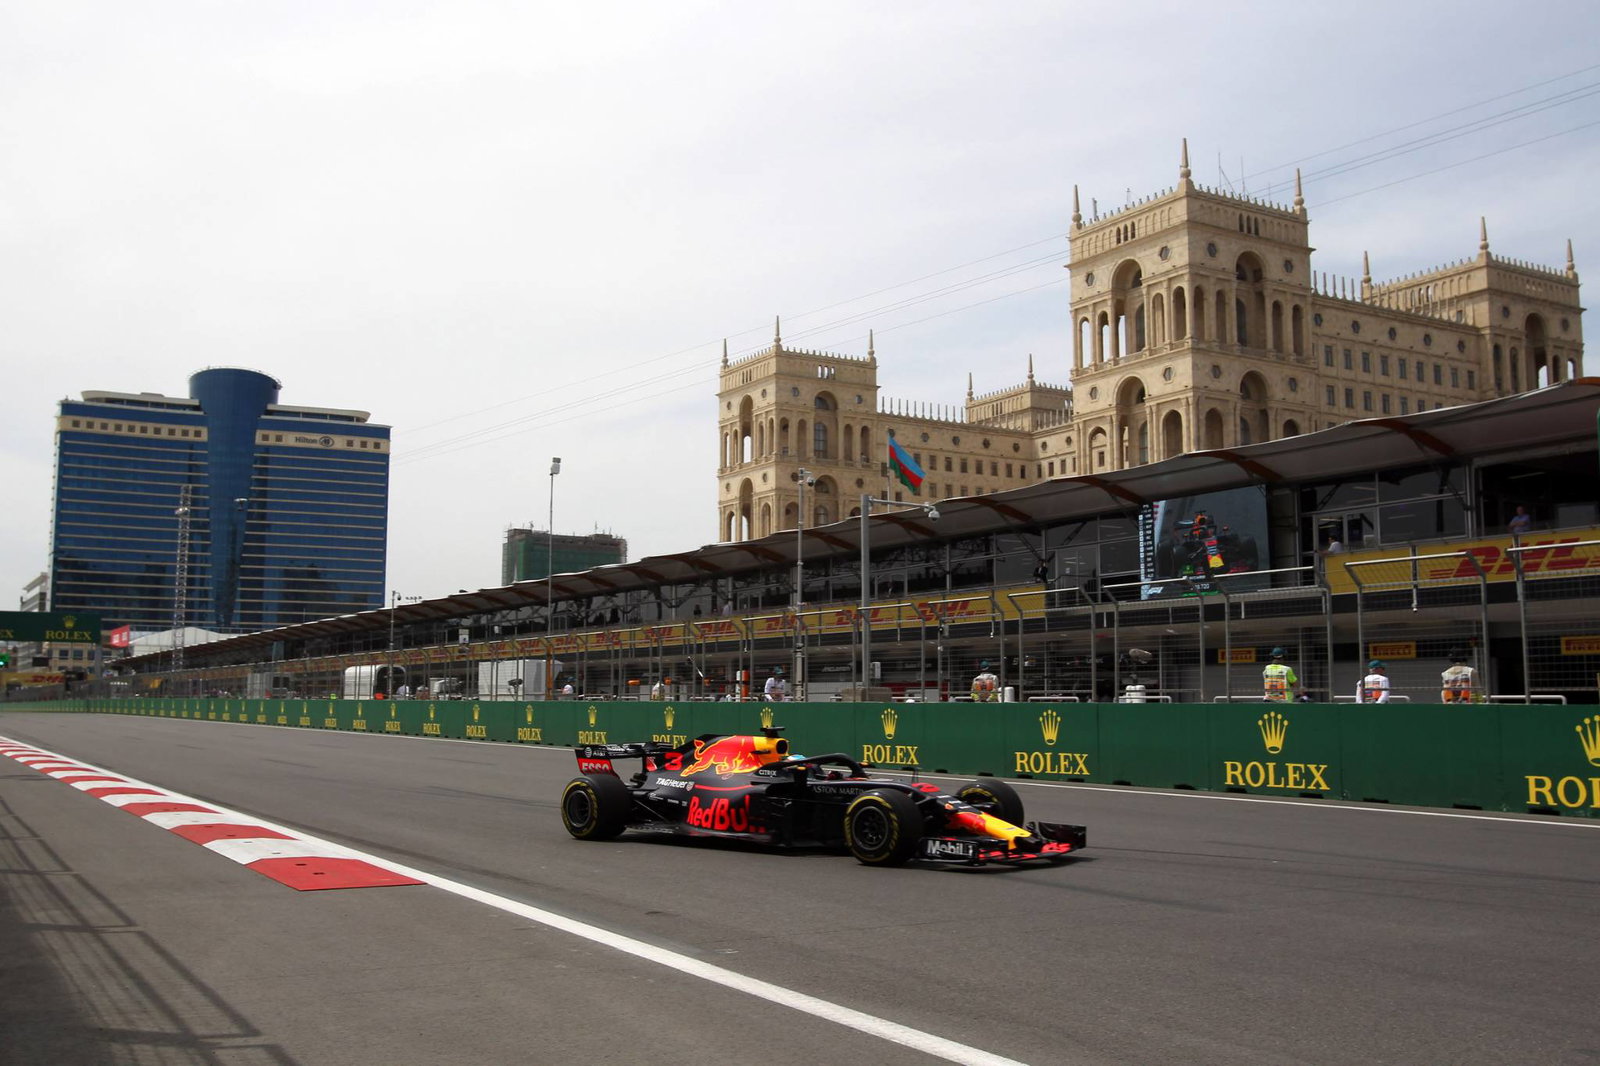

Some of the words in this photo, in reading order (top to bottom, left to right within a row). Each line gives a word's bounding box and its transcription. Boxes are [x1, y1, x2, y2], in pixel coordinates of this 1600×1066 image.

[295, 436, 318, 444] Hilton
[1453, 538, 1589, 577] DHL
[45, 629, 92, 640] ROLEX
[423, 723, 441, 734] ROLEX
[466, 725, 487, 737] ROLEX
[517, 728, 541, 741] ROLEX
[578, 731, 607, 745] ROLEX
[664, 752, 683, 770] 3
[862, 744, 919, 765] ROLEX
[1014, 751, 1090, 776] ROLEX
[759, 769, 777, 777] CITRIX
[1224, 761, 1330, 790] ROLEX
[927, 838, 964, 856] Mobil
